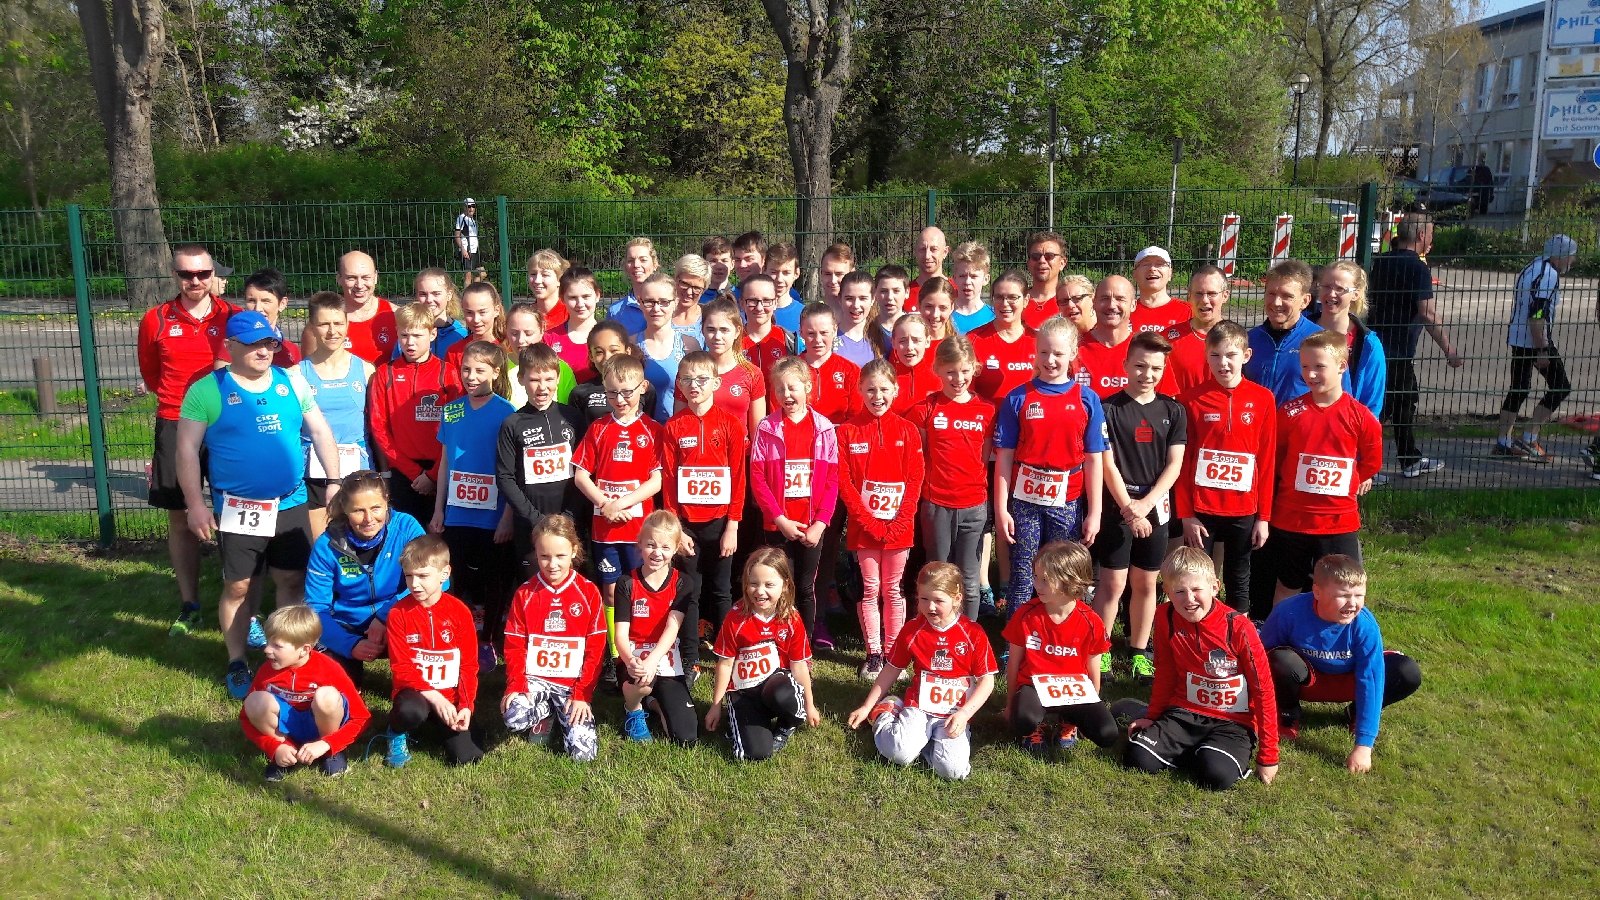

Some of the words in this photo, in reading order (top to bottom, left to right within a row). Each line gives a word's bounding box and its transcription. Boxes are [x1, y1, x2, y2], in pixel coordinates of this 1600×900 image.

[1008, 362, 1034, 370] OSPA
[1101, 377, 1128, 387] OSP
[444, 402, 464, 412] city
[258, 423, 282, 433] sport
[523, 427, 542, 437] city
[954, 420, 983, 431] OSPA
[524, 433, 545, 445] sport
[533, 457, 565, 476] 634
[1318, 461, 1338, 469] OSPA
[1035, 473, 1053, 482] OSPA
[1206, 463, 1242, 482] 625
[1306, 467, 1342, 487] 632
[456, 484, 489, 502] 650
[610, 484, 628, 492] OSPA
[687, 479, 721, 496] 626
[1023, 479, 1057, 499] 644
[244, 502, 263, 510] OSPA
[869, 494, 899, 511] 624
[237, 510, 260, 527] 13
[1045, 644, 1078, 656] OSPA
[424, 654, 444, 662] OSPA
[536, 650, 571, 668] 631
[737, 658, 770, 680] 620
[930, 685, 966, 707] 649
[1047, 683, 1087, 699] 643
[1196, 688, 1237, 707] 635
